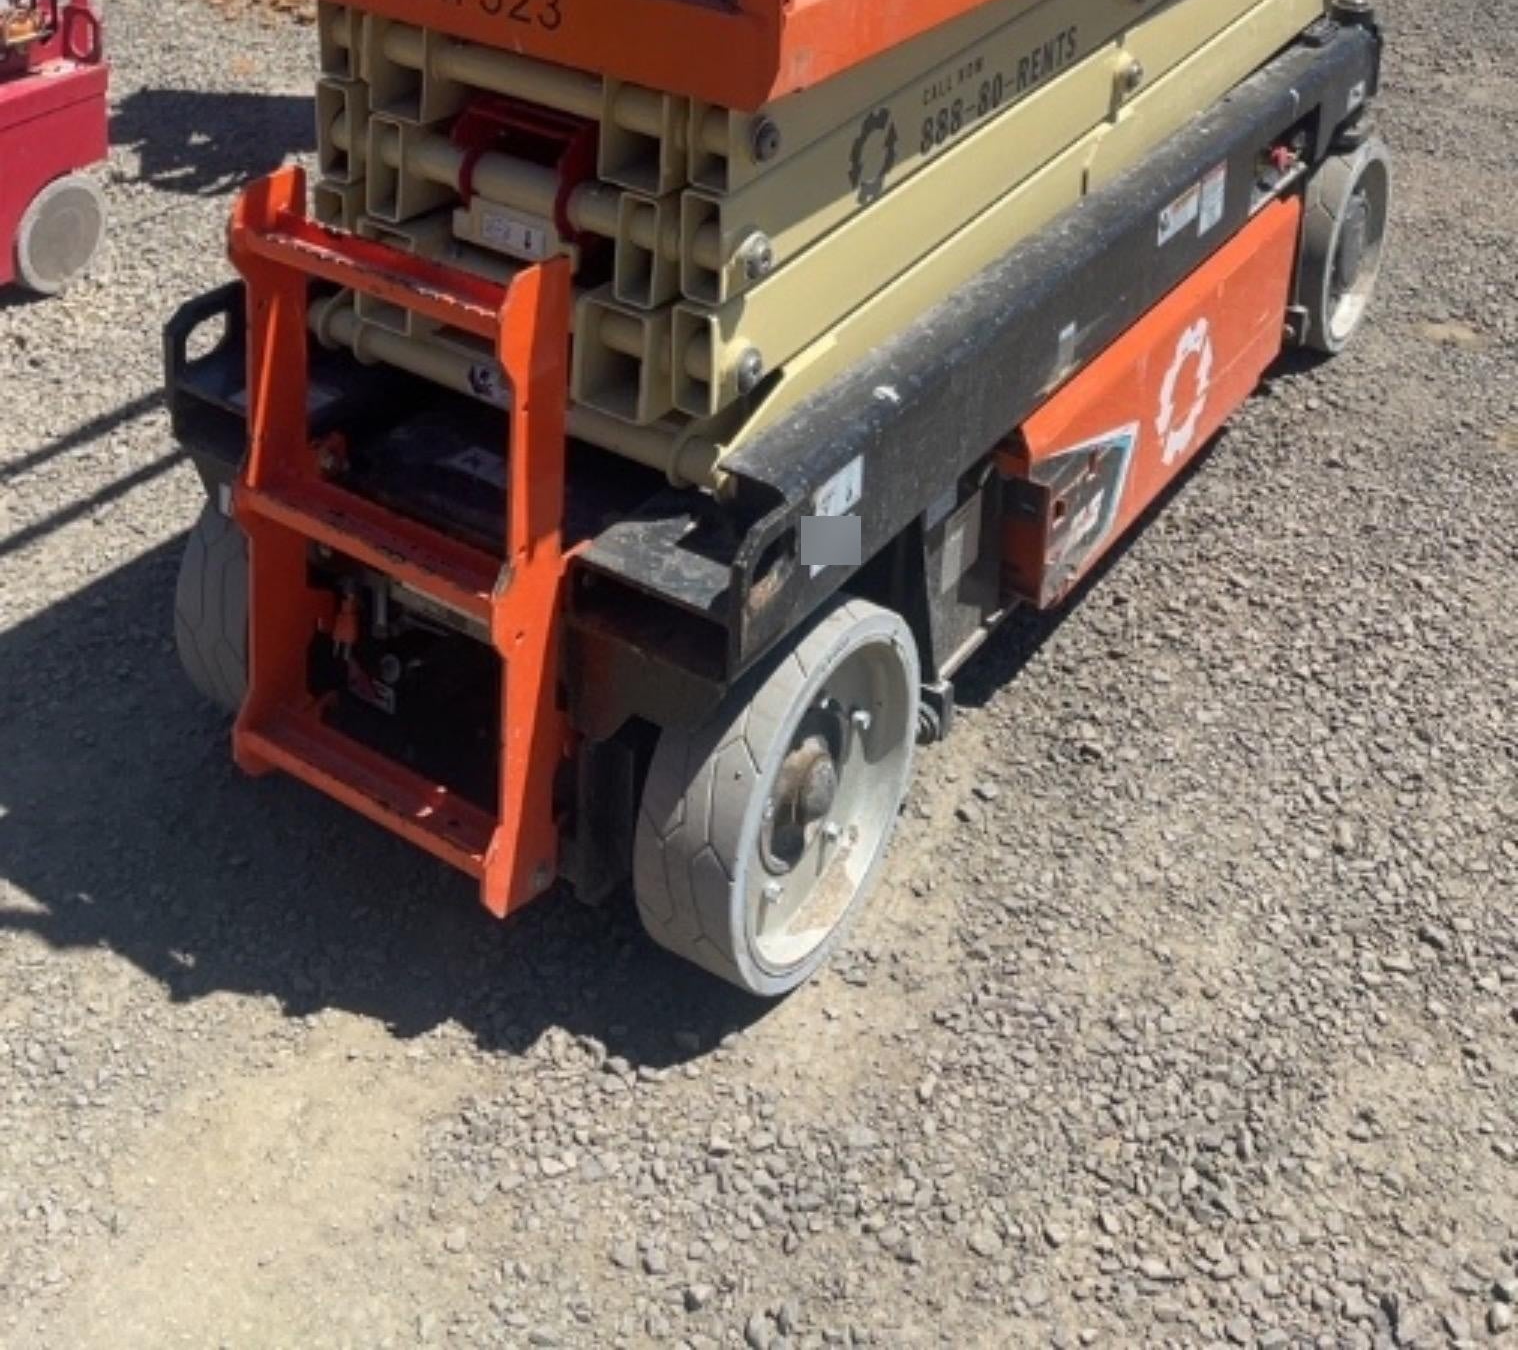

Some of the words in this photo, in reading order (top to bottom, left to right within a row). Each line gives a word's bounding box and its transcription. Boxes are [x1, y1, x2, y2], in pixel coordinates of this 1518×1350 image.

[920, 23, 1078, 156] 888-80-RENTS
[922, 74, 953, 106] CALL
[957, 56, 985, 83] NOW
